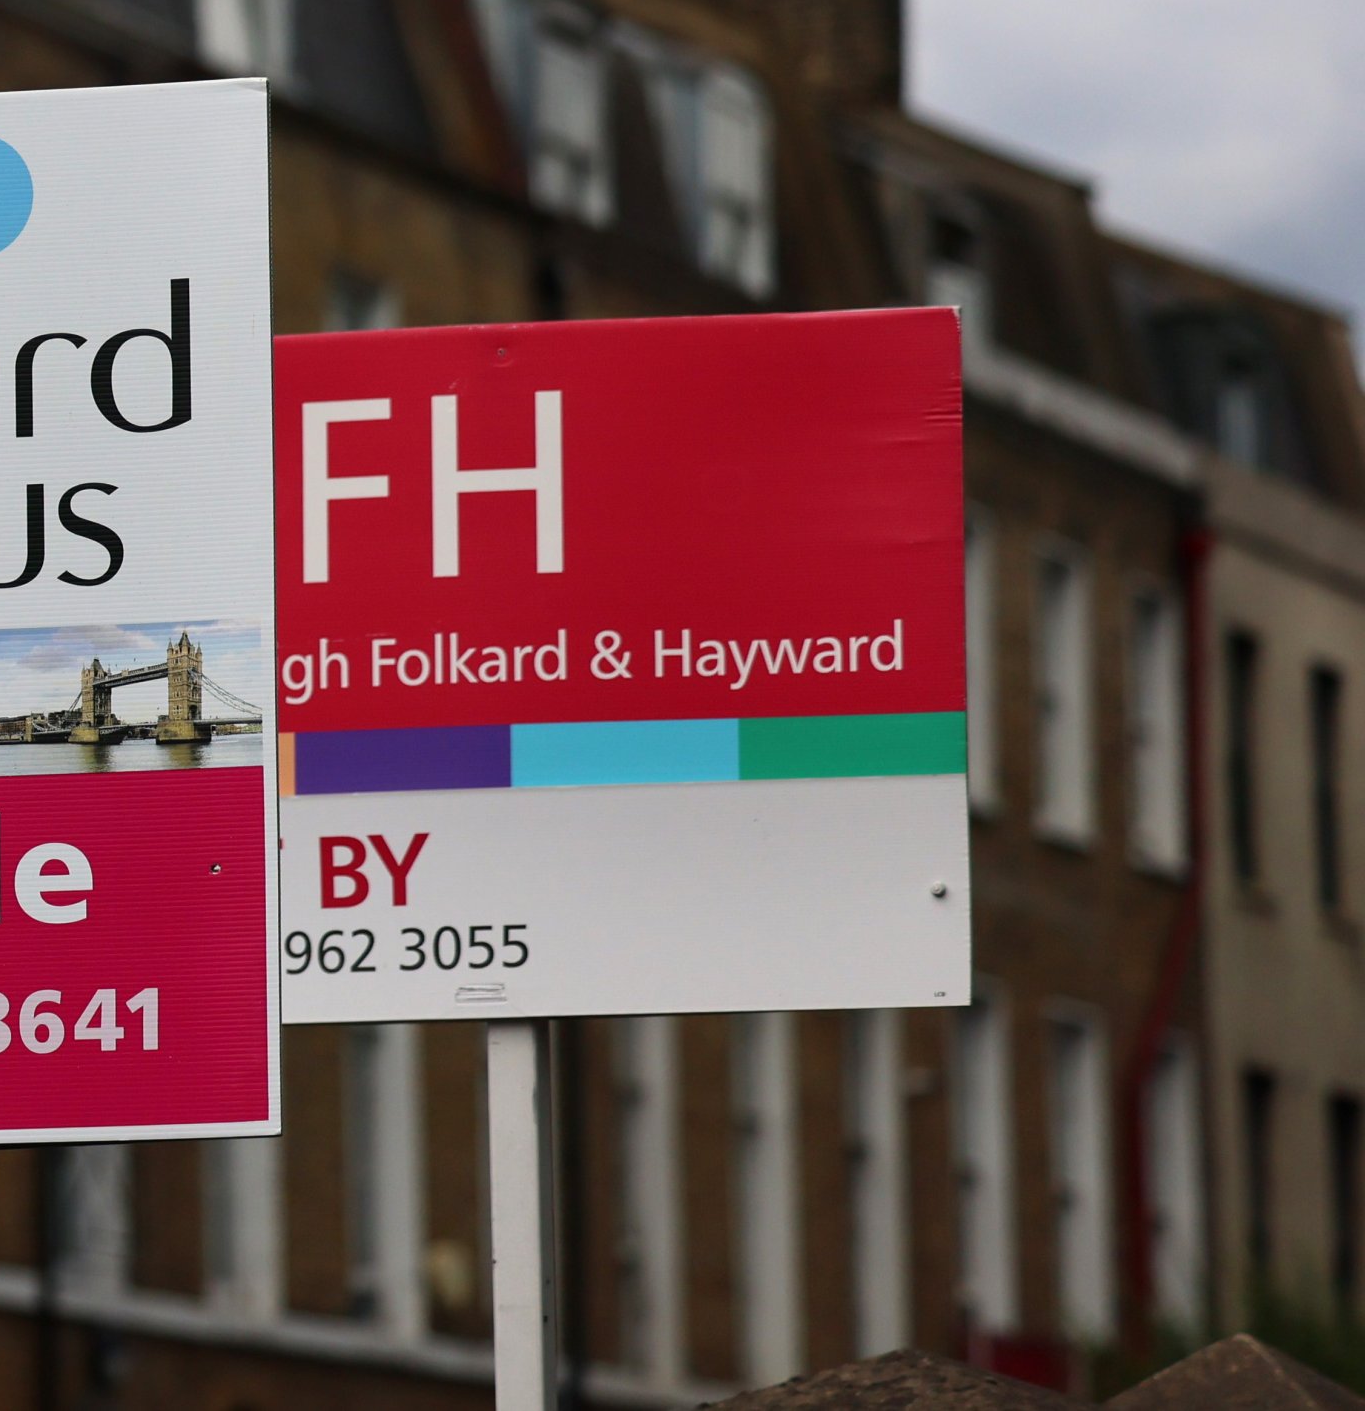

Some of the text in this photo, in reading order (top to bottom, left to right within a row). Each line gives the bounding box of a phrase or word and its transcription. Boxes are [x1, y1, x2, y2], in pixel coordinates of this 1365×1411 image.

[302, 390, 564, 583] FH
[371, 628, 567, 687] Folkard
[590, 630, 632, 680] &
[654, 618, 904, 689] Hayward
[319, 832, 430, 909] BY
[399, 924, 529, 971] 3055
